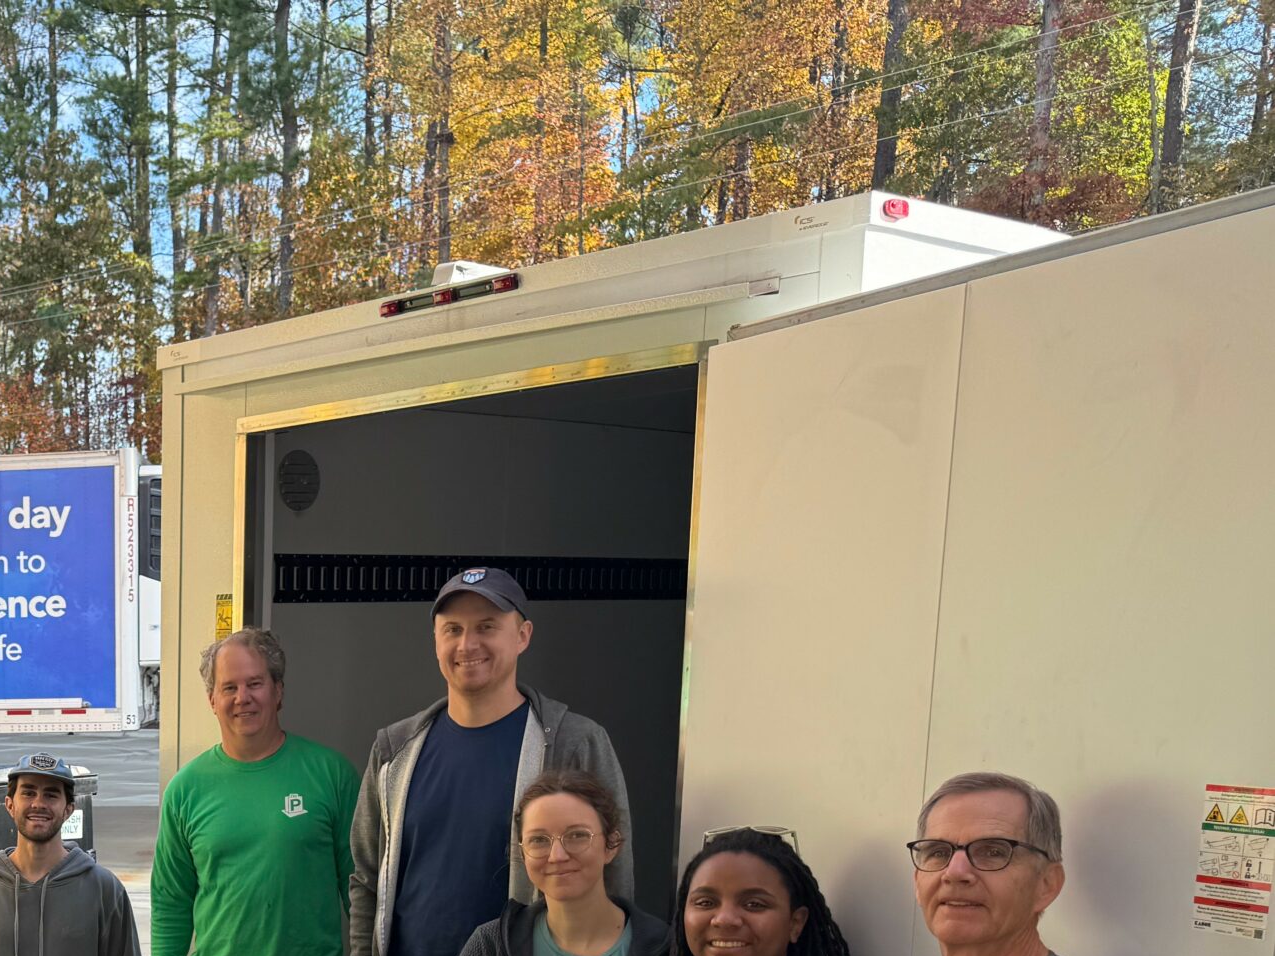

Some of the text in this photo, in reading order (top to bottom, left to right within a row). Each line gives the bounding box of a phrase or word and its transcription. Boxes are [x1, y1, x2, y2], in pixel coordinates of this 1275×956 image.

[8, 496, 71, 538] day
[16, 550, 46, 573] to
[126, 714, 135, 725] 53
